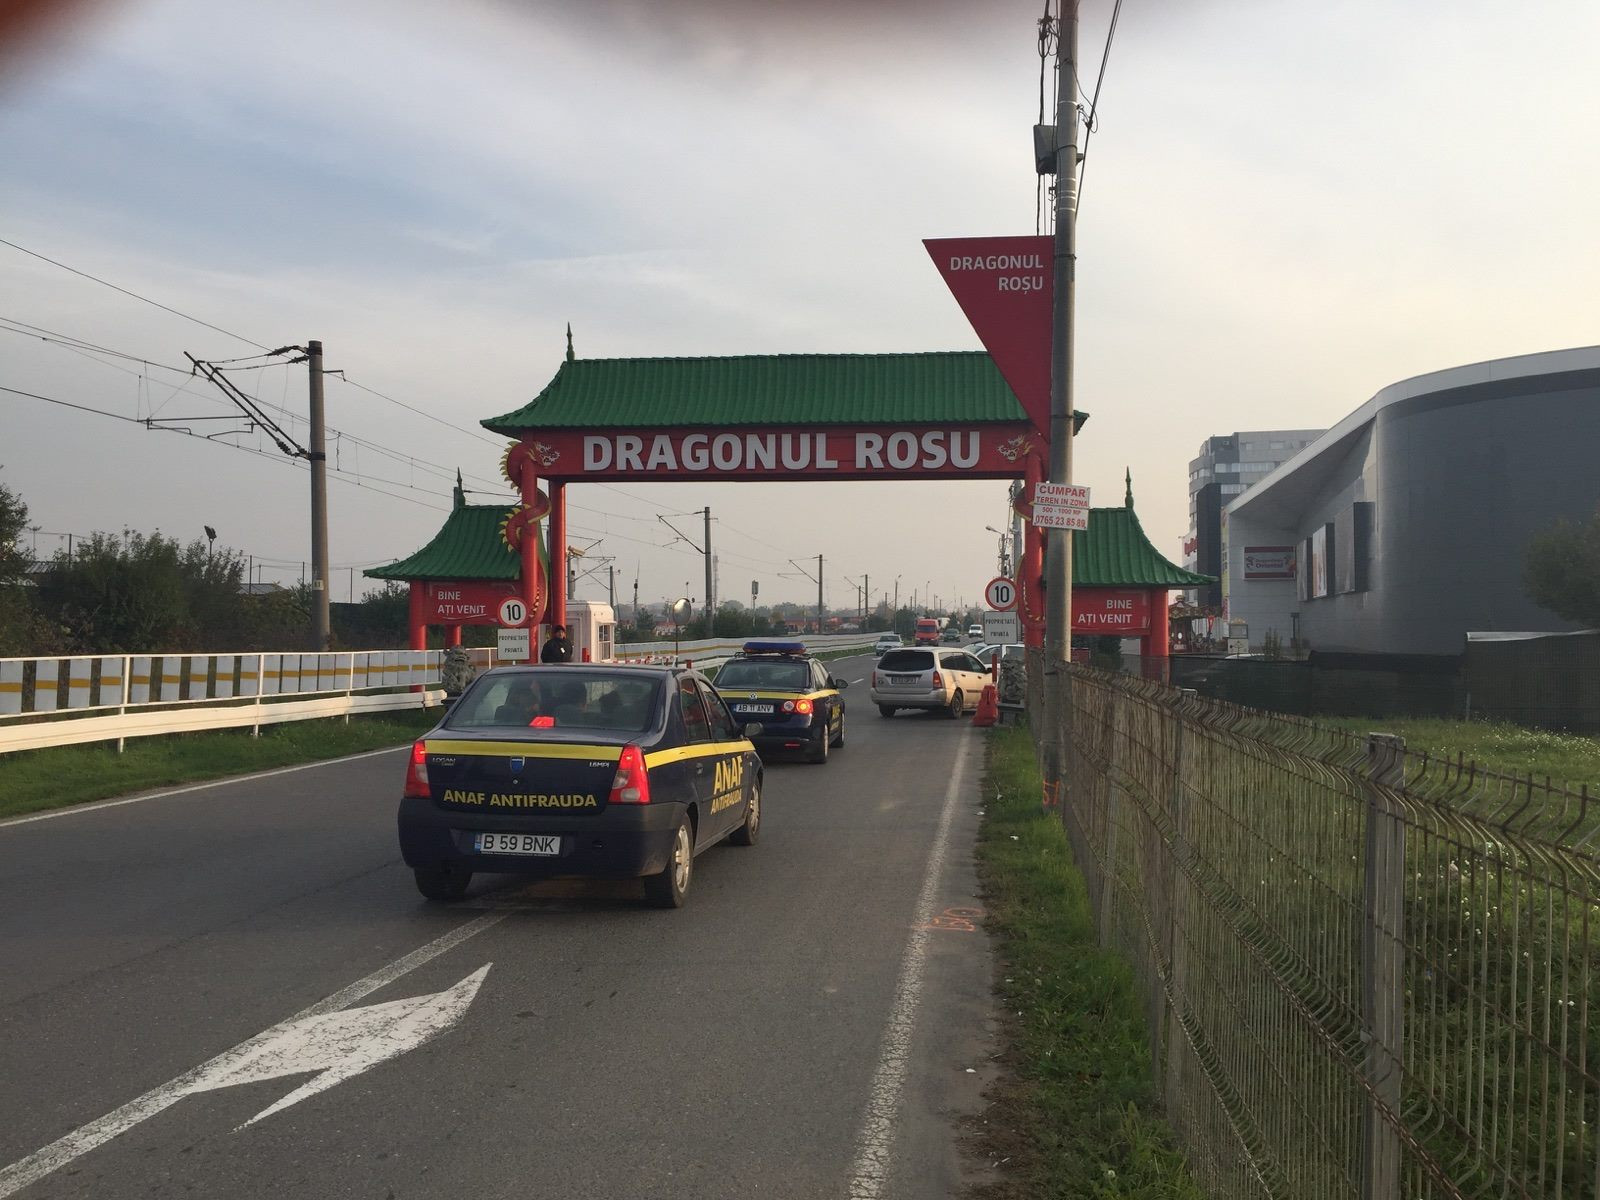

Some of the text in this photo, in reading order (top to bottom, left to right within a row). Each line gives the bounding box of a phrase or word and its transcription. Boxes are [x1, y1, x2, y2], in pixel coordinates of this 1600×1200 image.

[950, 254, 1044, 271] DRAGONUL
[998, 276, 1043, 295] ROȘU
[583, 430, 981, 472] DRAGONUL ROSU
[1040, 486, 1085, 498] CUMPAR
[1036, 497, 1058, 505] TEREN
[1035, 515, 1054, 525] 0765
[1055, 516, 1065, 526] 23
[1066, 518, 1076, 527] 85
[437, 590, 461, 600] BINE
[994, 585, 1010, 604] 10
[456, 604, 486, 614] VENIT
[506, 603, 521, 621] 10
[1106, 599, 1133, 609] BINE
[1099, 613, 1133, 624] VENIT
[737, 704, 748, 712] AB
[713, 755, 744, 796] ANAF
[443, 788, 598, 808] ANAF ANTIFRAUDA
[710, 787, 742, 816] ANTIFRAUDA
[483, 834, 556, 853] B 59 BNK
